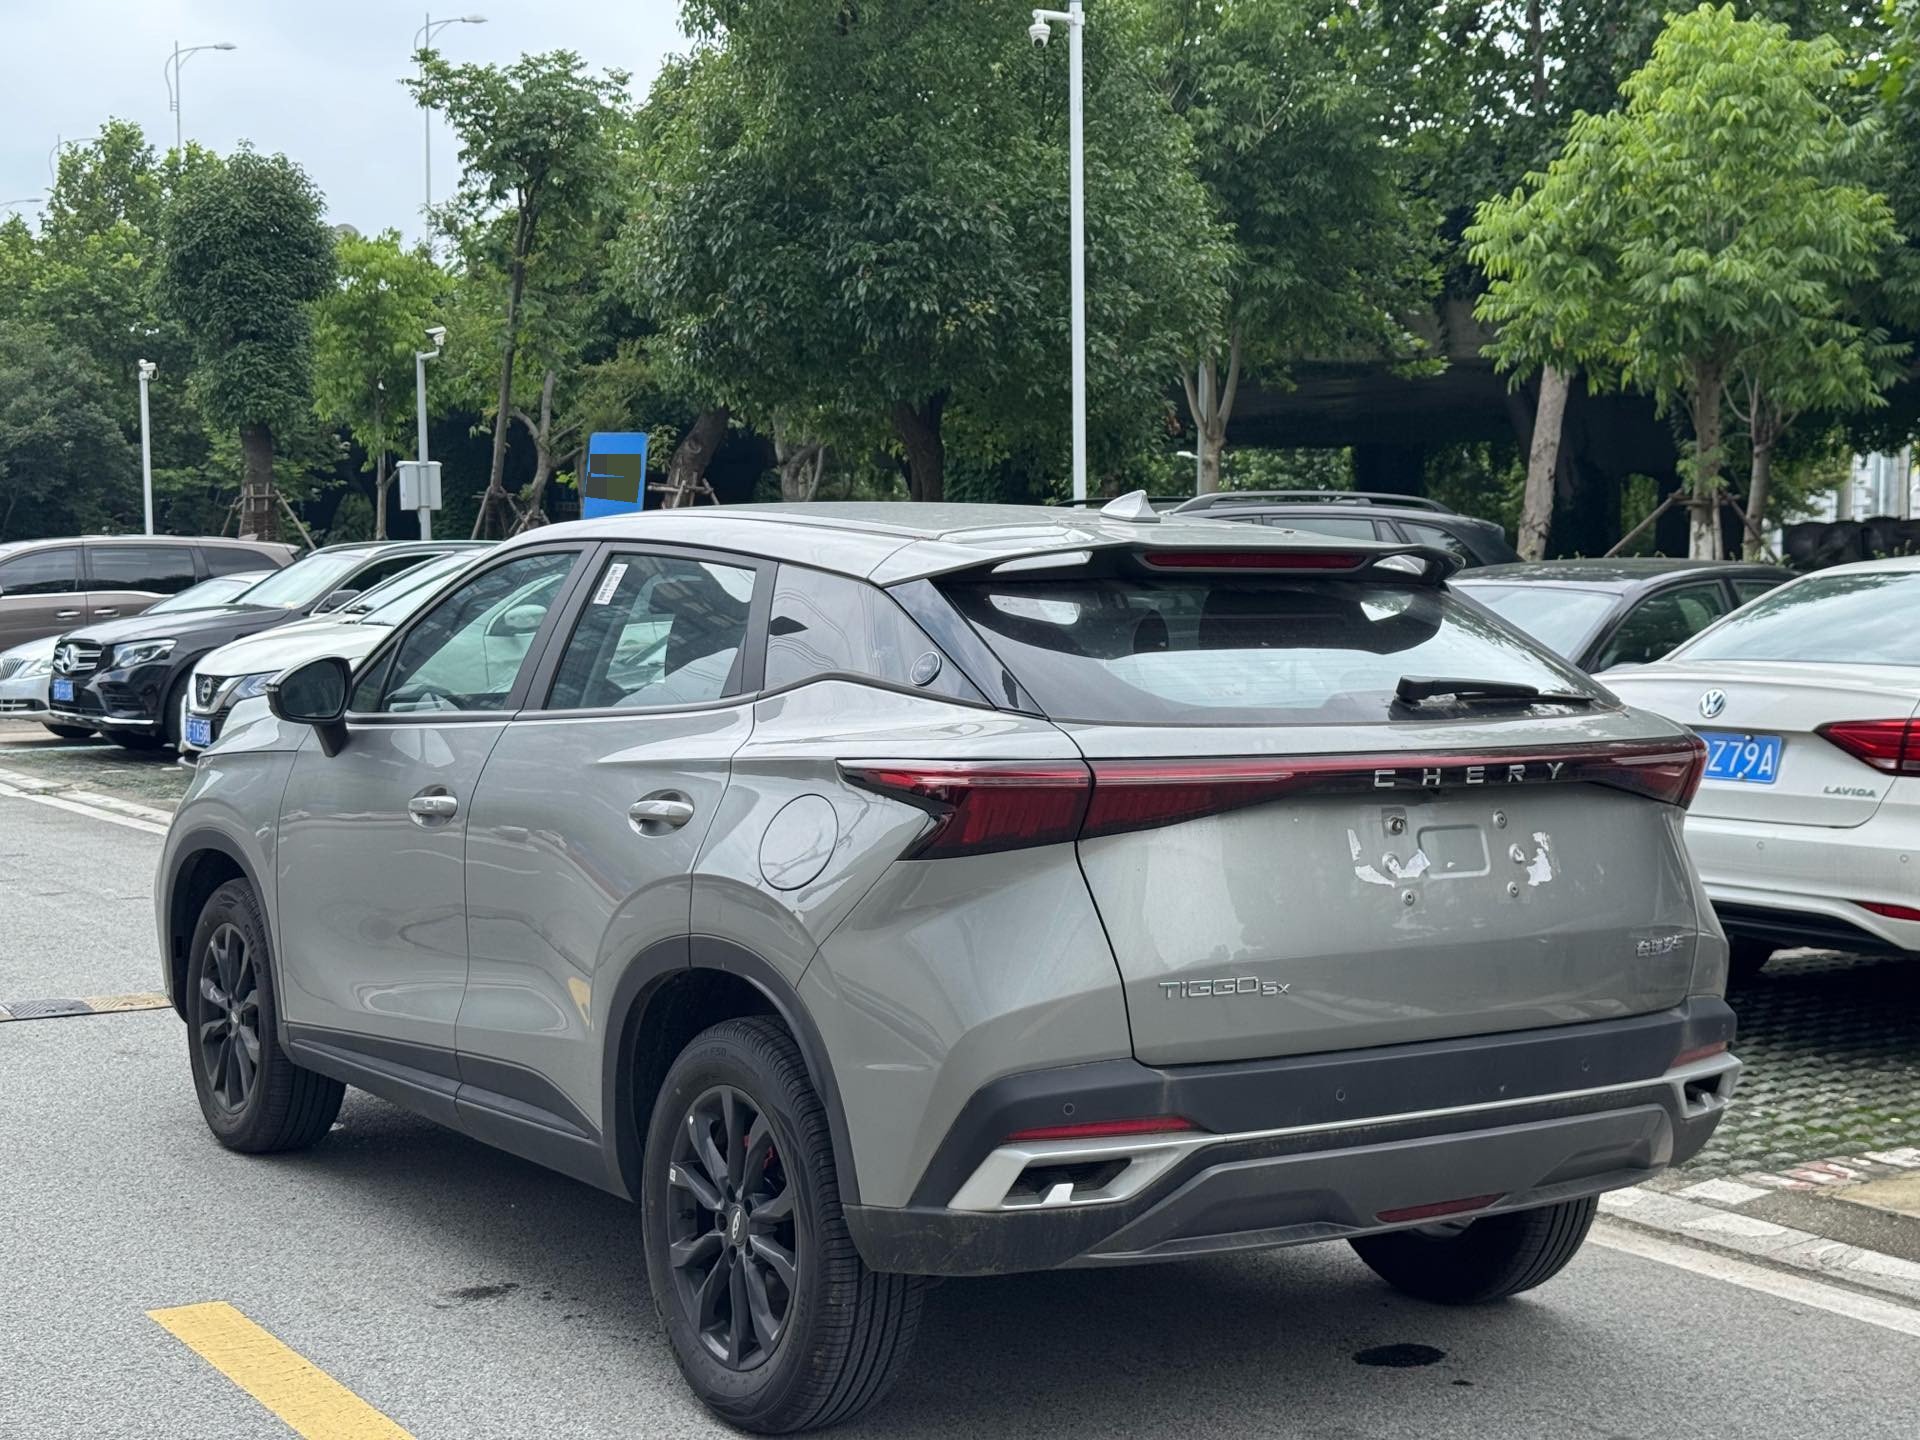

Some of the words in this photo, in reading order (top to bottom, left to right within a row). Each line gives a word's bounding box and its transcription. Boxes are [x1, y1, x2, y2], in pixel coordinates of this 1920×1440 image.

[1374, 762, 1564, 788] CHERY
[1823, 785, 1876, 798] LAVIDA
[1158, 976, 1259, 999] TIGGO
